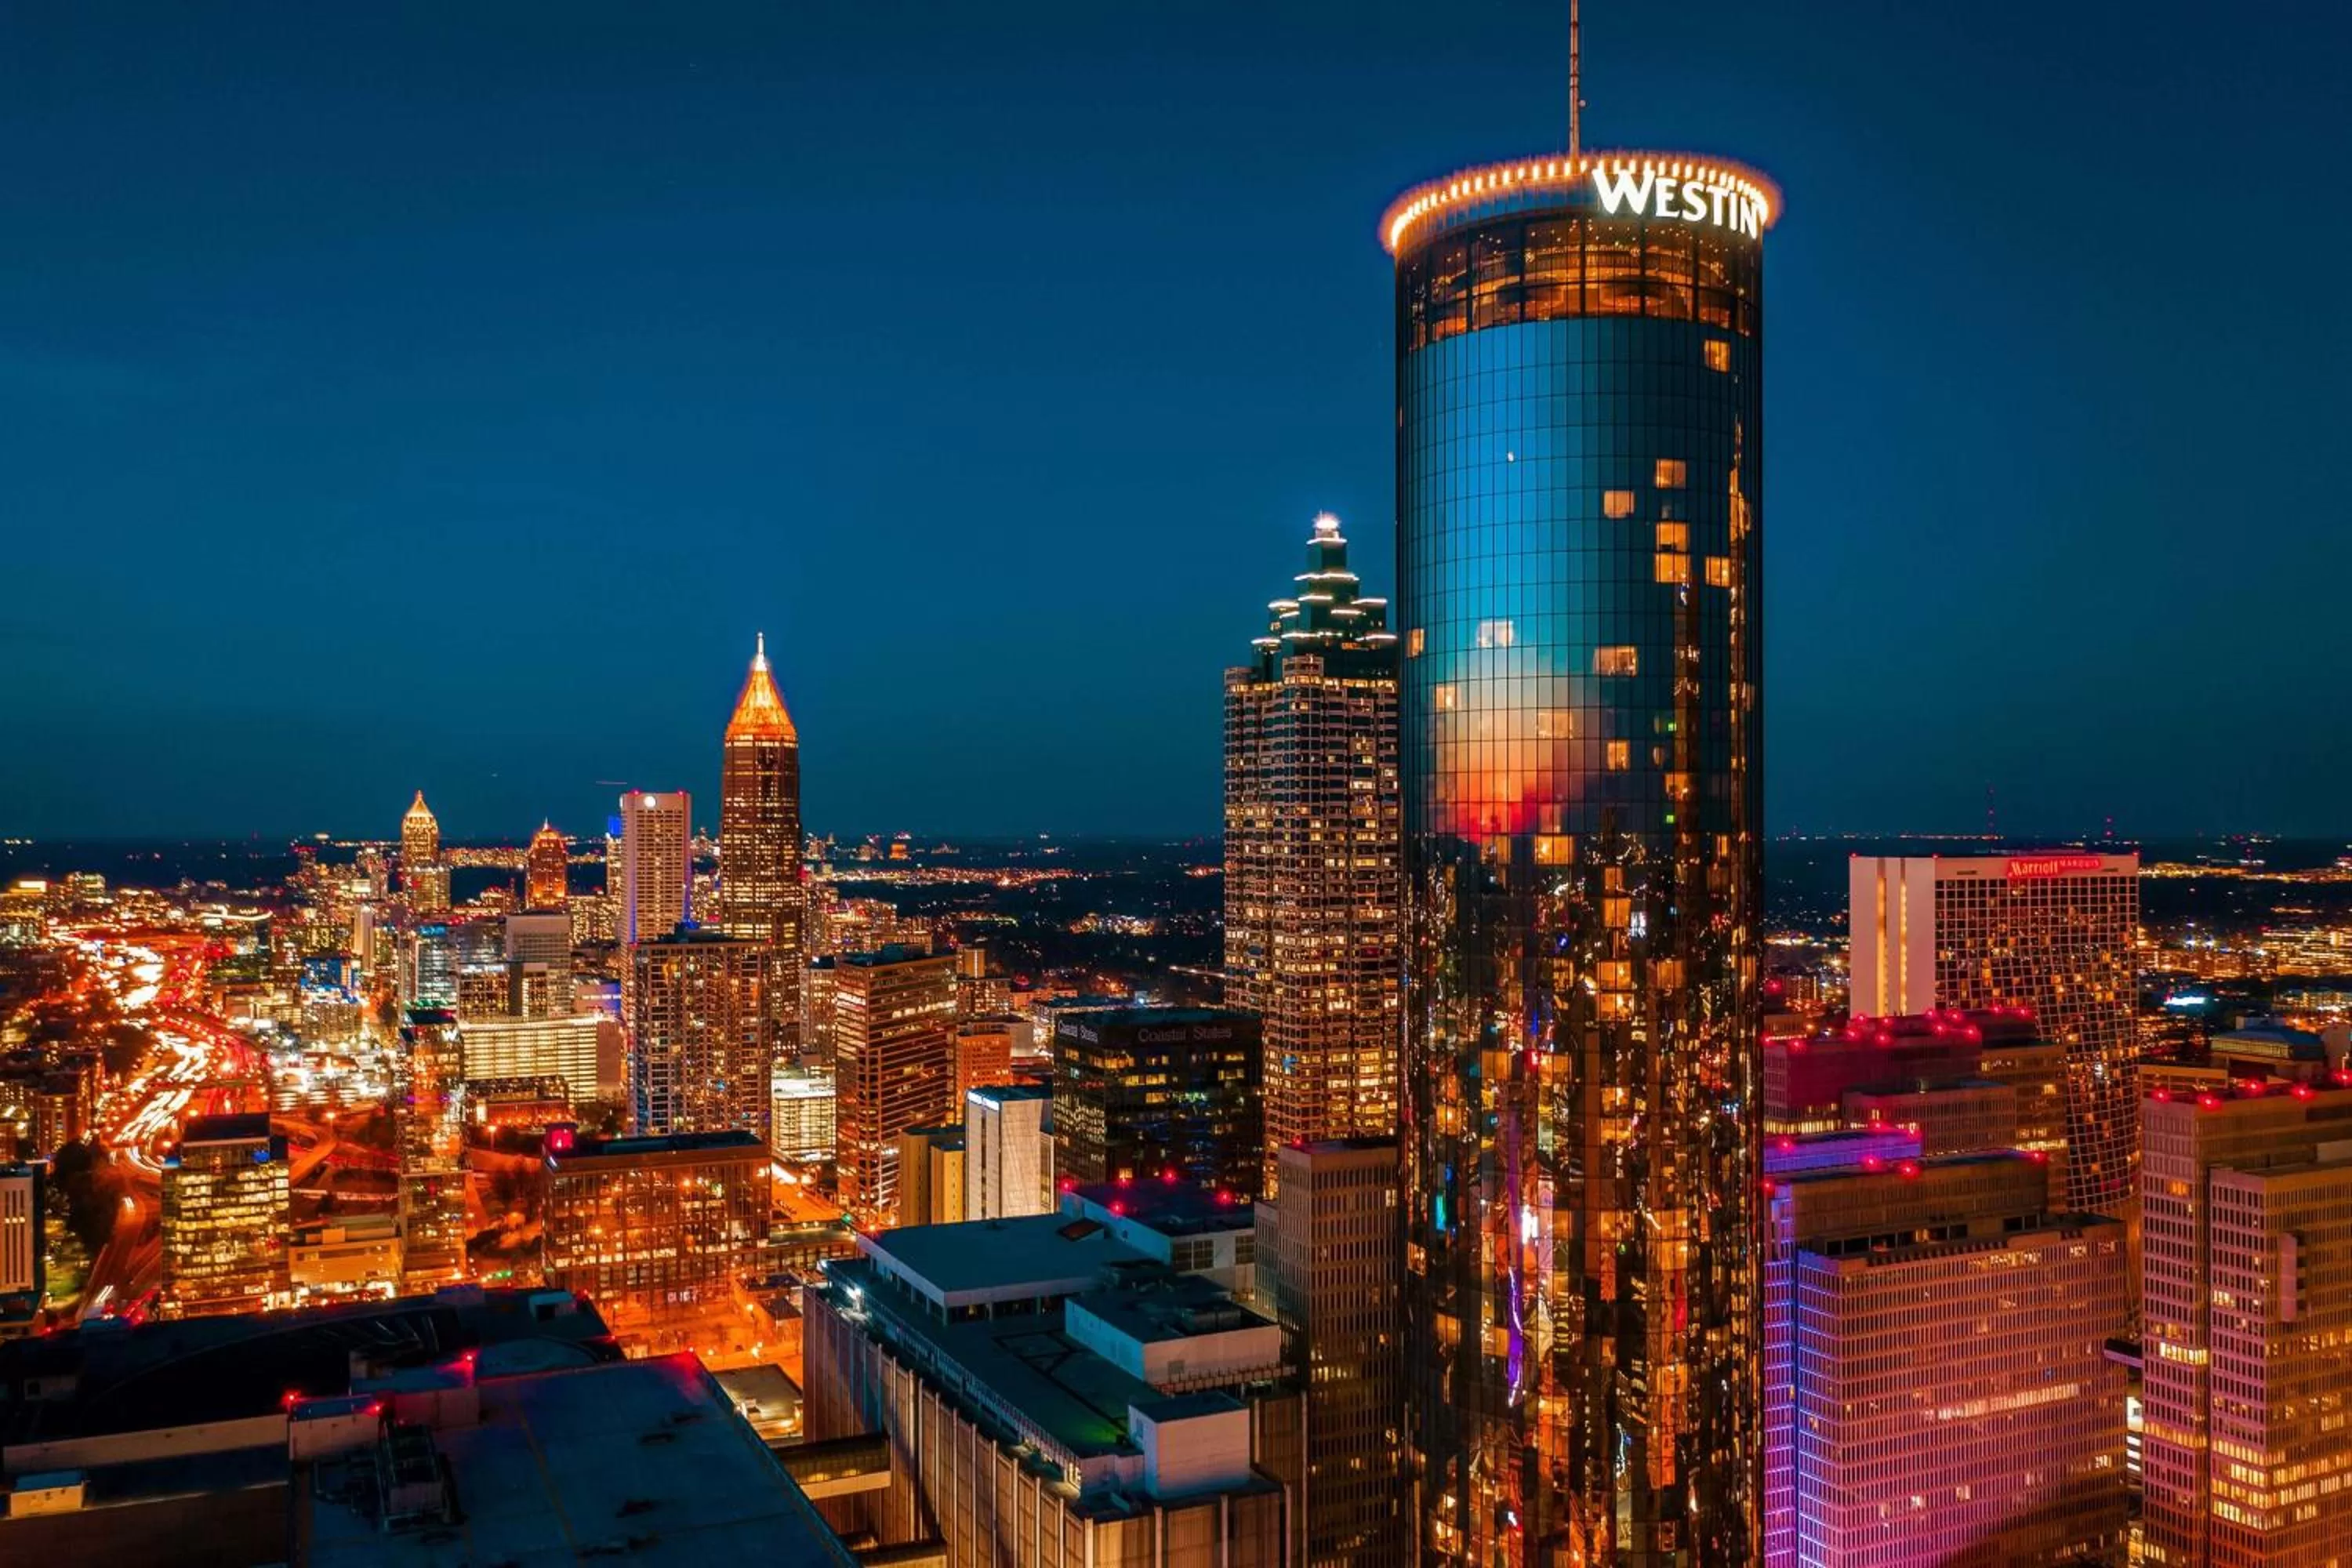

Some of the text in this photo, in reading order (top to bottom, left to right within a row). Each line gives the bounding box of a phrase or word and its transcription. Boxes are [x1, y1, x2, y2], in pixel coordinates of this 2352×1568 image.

[1592, 168, 1761, 240] WESTIN
[2008, 859, 2058, 877] Marriott
[1138, 1025, 1232, 1043] Coastal States
